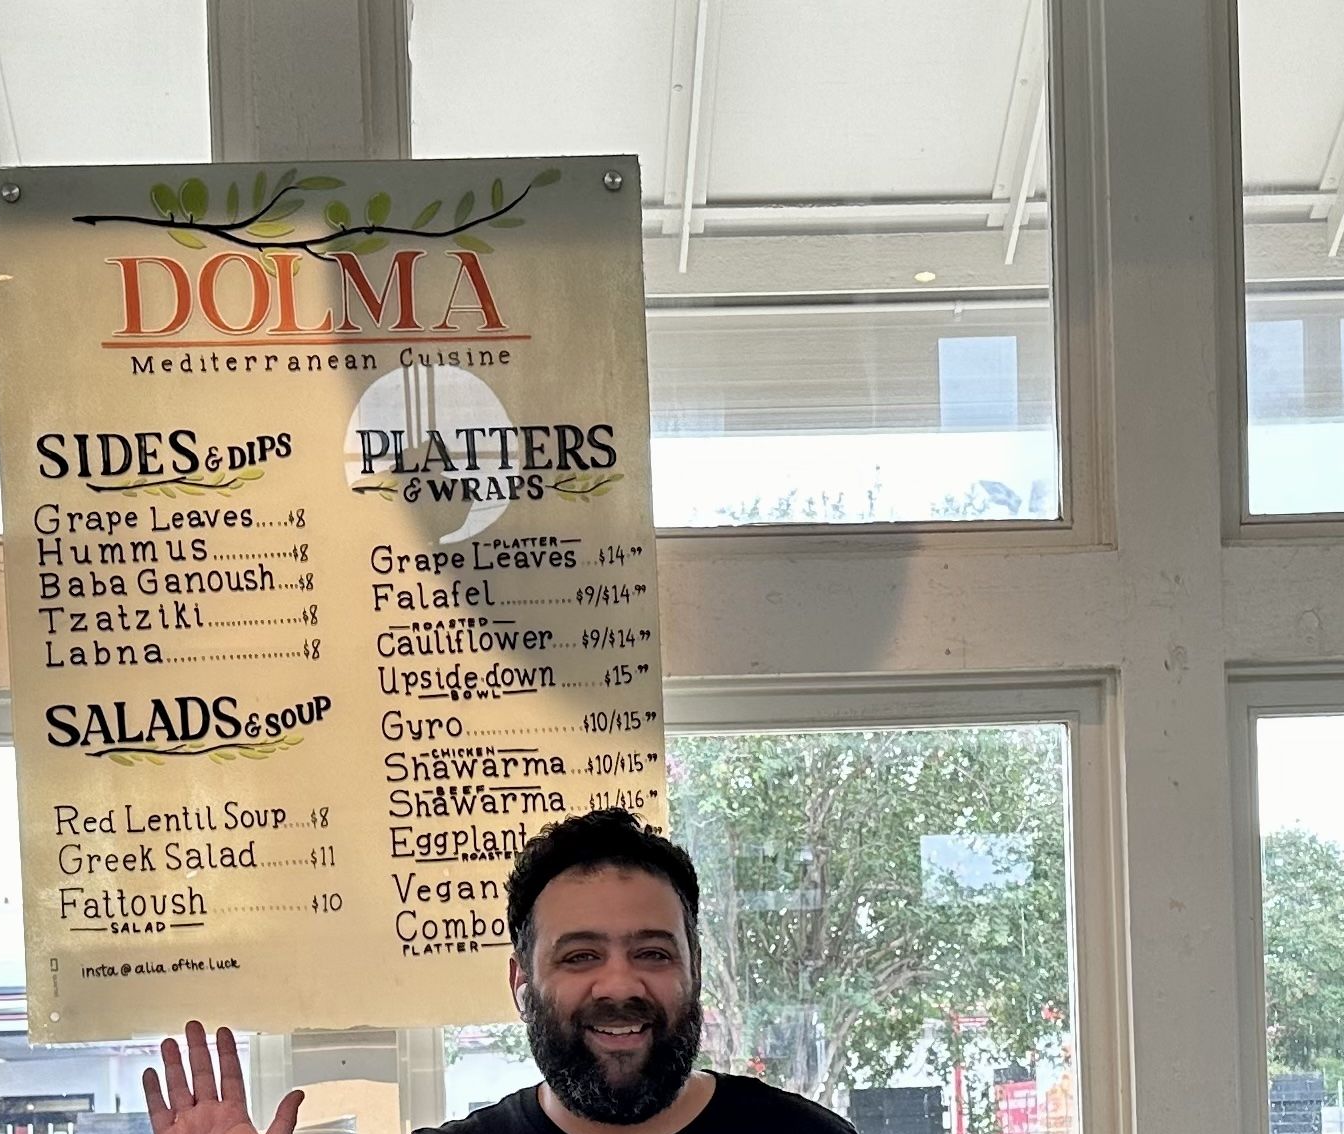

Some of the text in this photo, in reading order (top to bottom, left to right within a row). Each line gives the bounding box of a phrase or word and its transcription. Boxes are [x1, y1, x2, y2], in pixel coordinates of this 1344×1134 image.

[105, 249, 509, 337] DOLMA
[131, 345, 511, 375] Mediterranean Cuisine
[36, 429, 293, 479] SIDES & DIPS
[356, 424, 617, 474] PLATTERS
[403, 474, 544, 502] & WRAPS
[34, 504, 138, 534] Grape
[150, 506, 253, 532] Leaves
[37, 538, 208, 566] Hummus
[371, 544, 465, 575] Grape
[472, 541, 577, 570] Leaves
[493, 536, 558, 550] PLATTER
[39, 572, 127, 599] Baba
[137, 564, 275, 594] Ganoush
[372, 580, 495, 611] Falafel
[38, 601, 204, 634] Tzatziki
[412, 617, 489, 631] ROASTED
[45, 639, 164, 668] Labna
[377, 629, 553, 657] Cauliflower
[450, 688, 501, 700] BOWL
[45, 695, 332, 747] SALADS & SOUP
[382, 710, 463, 741] Gyro
[385, 752, 566, 782] Shawarma
[431, 746, 496, 758] CHICKEN
[389, 789, 566, 818] Shawarma
[436, 785, 486, 796] BEEF
[54, 805, 116, 835] Red
[125, 805, 217, 833] Lentil
[224, 801, 286, 829] Soup
[390, 823, 527, 858] Eggplant
[58, 843, 156, 875] Greek
[164, 841, 257, 871] Salad
[60, 887, 343, 918] Fattoush $10
[110, 921, 166, 935] SALAD
[395, 910, 506, 942] Combo
[403, 941, 479, 957] PLATTER
